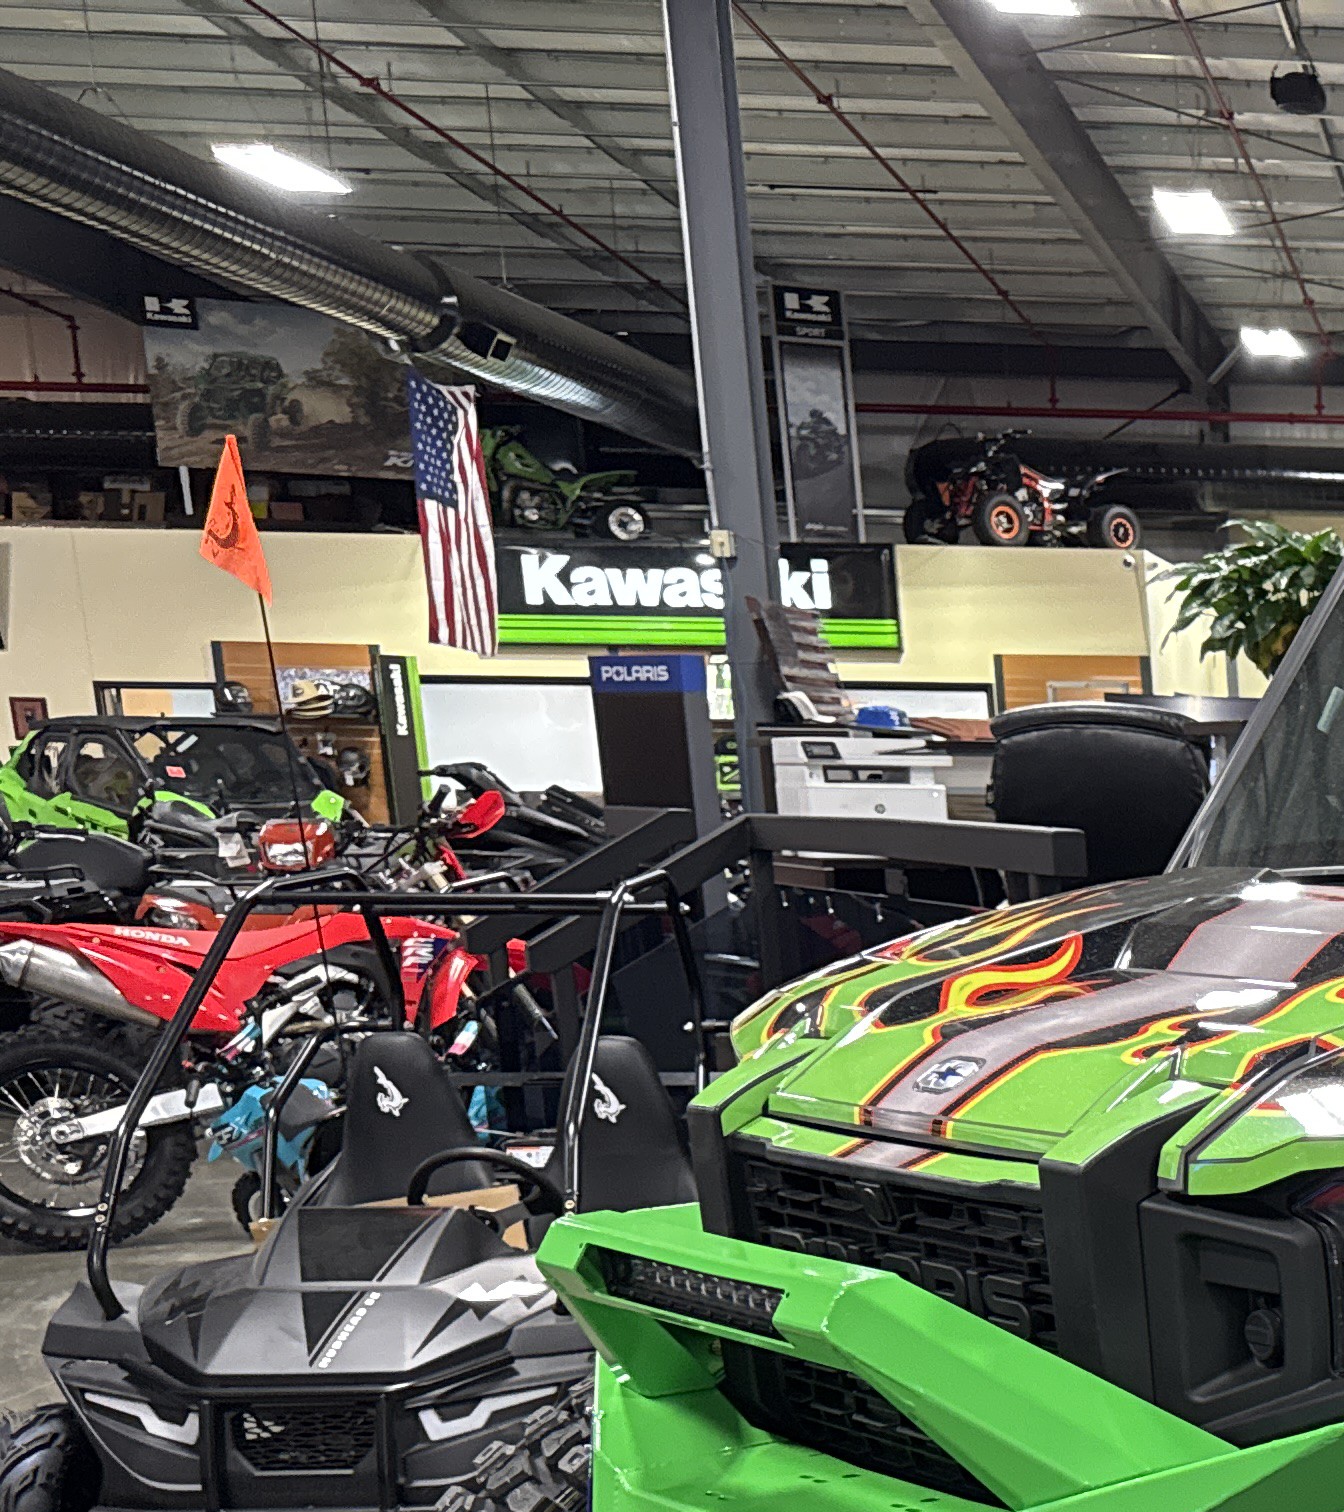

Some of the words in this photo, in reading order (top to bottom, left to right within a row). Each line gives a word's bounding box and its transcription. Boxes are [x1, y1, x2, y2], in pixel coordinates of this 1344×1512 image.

[520, 553, 833, 611] Kawaski
[601, 664, 670, 682] POLARIS
[388, 663, 409, 737] Kawasaki
[113, 925, 191, 947] HONDA
